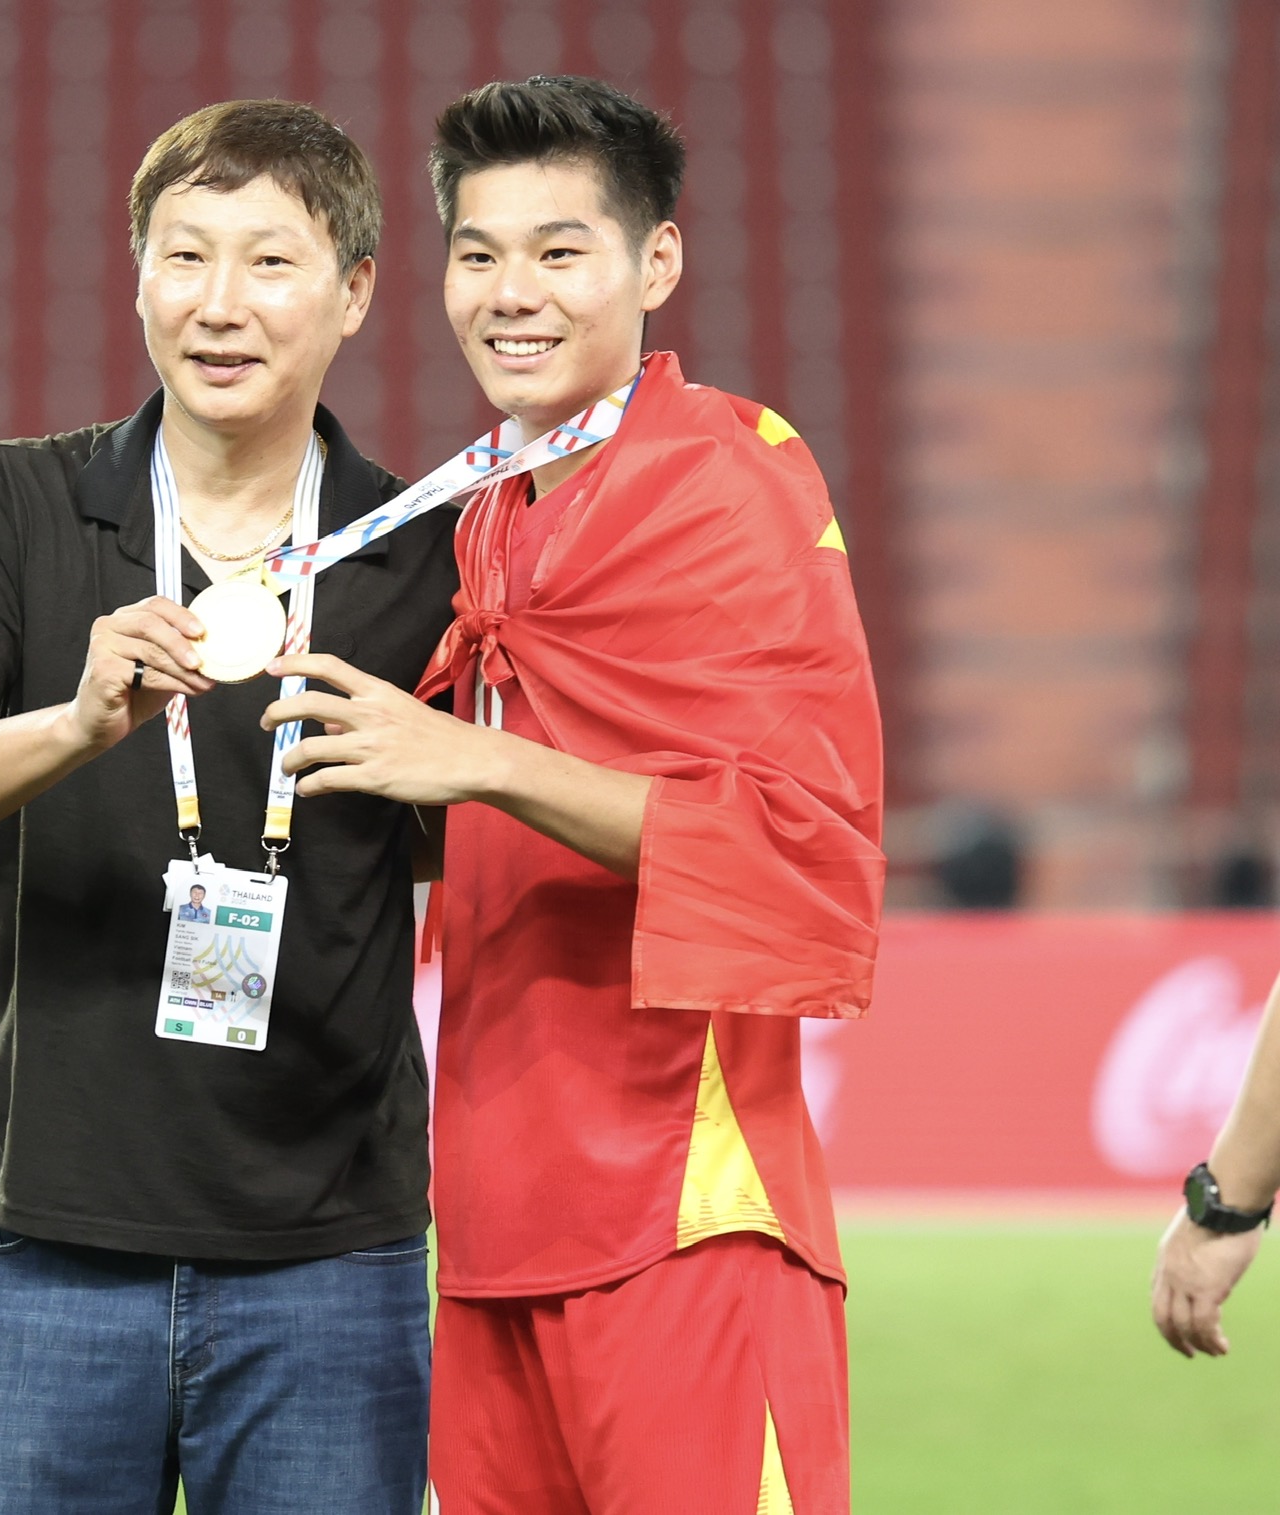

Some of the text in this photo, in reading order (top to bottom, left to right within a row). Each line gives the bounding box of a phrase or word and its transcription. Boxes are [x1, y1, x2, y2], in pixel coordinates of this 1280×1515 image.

[232, 890, 273, 902] THAILAND
[228, 912, 260, 927] F-02
[175, 1022, 183, 1032] S
